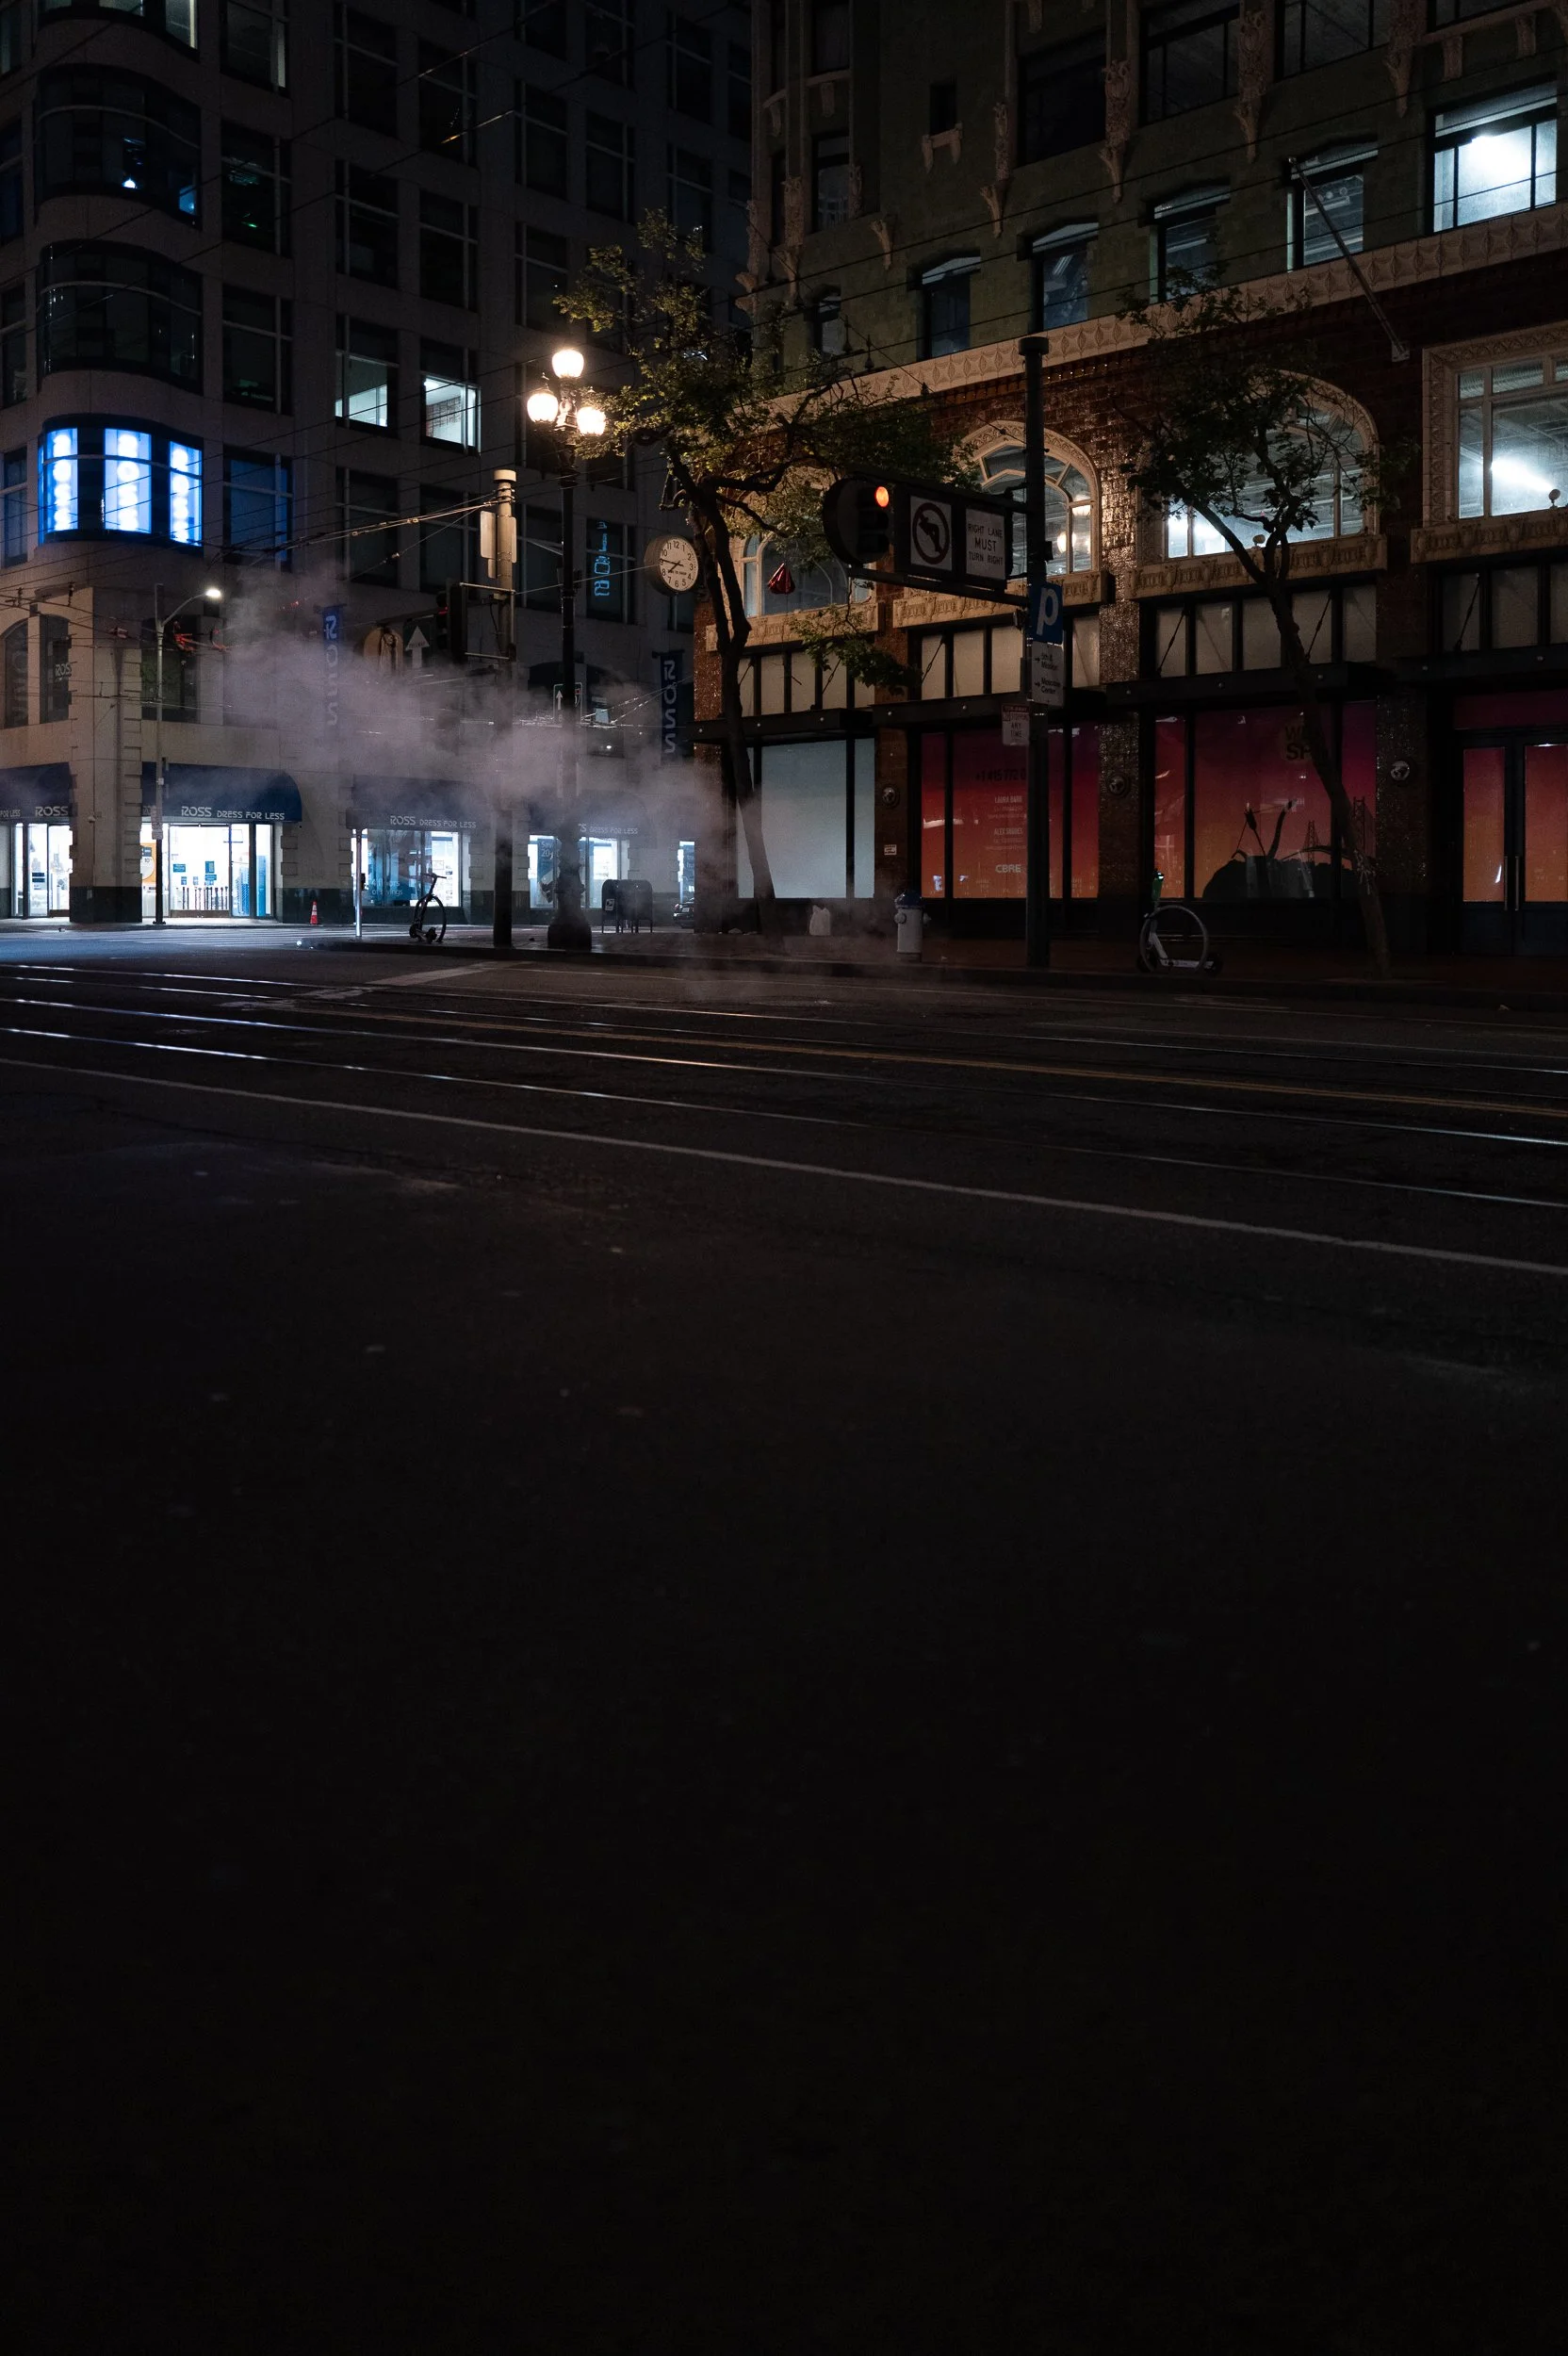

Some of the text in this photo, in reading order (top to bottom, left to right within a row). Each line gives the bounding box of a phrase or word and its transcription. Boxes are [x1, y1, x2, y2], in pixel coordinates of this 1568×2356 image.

[968, 523, 1003, 538] RIGHT LANE
[673, 540, 679, 549] 12
[974, 537, 997, 552] MUST
[968, 550, 1003, 565] TURN RIGHT
[1036, 587, 1059, 636] P
[663, 660, 678, 754] ROSS
[35, 806, 69, 817] ROSS
[181, 806, 212, 817] ROSS
[217, 810, 243, 819] DRESS
[389, 815, 416, 826] ROSS
[419, 819, 442, 827] DRESS
[994, 863, 1021, 874] CBRE
